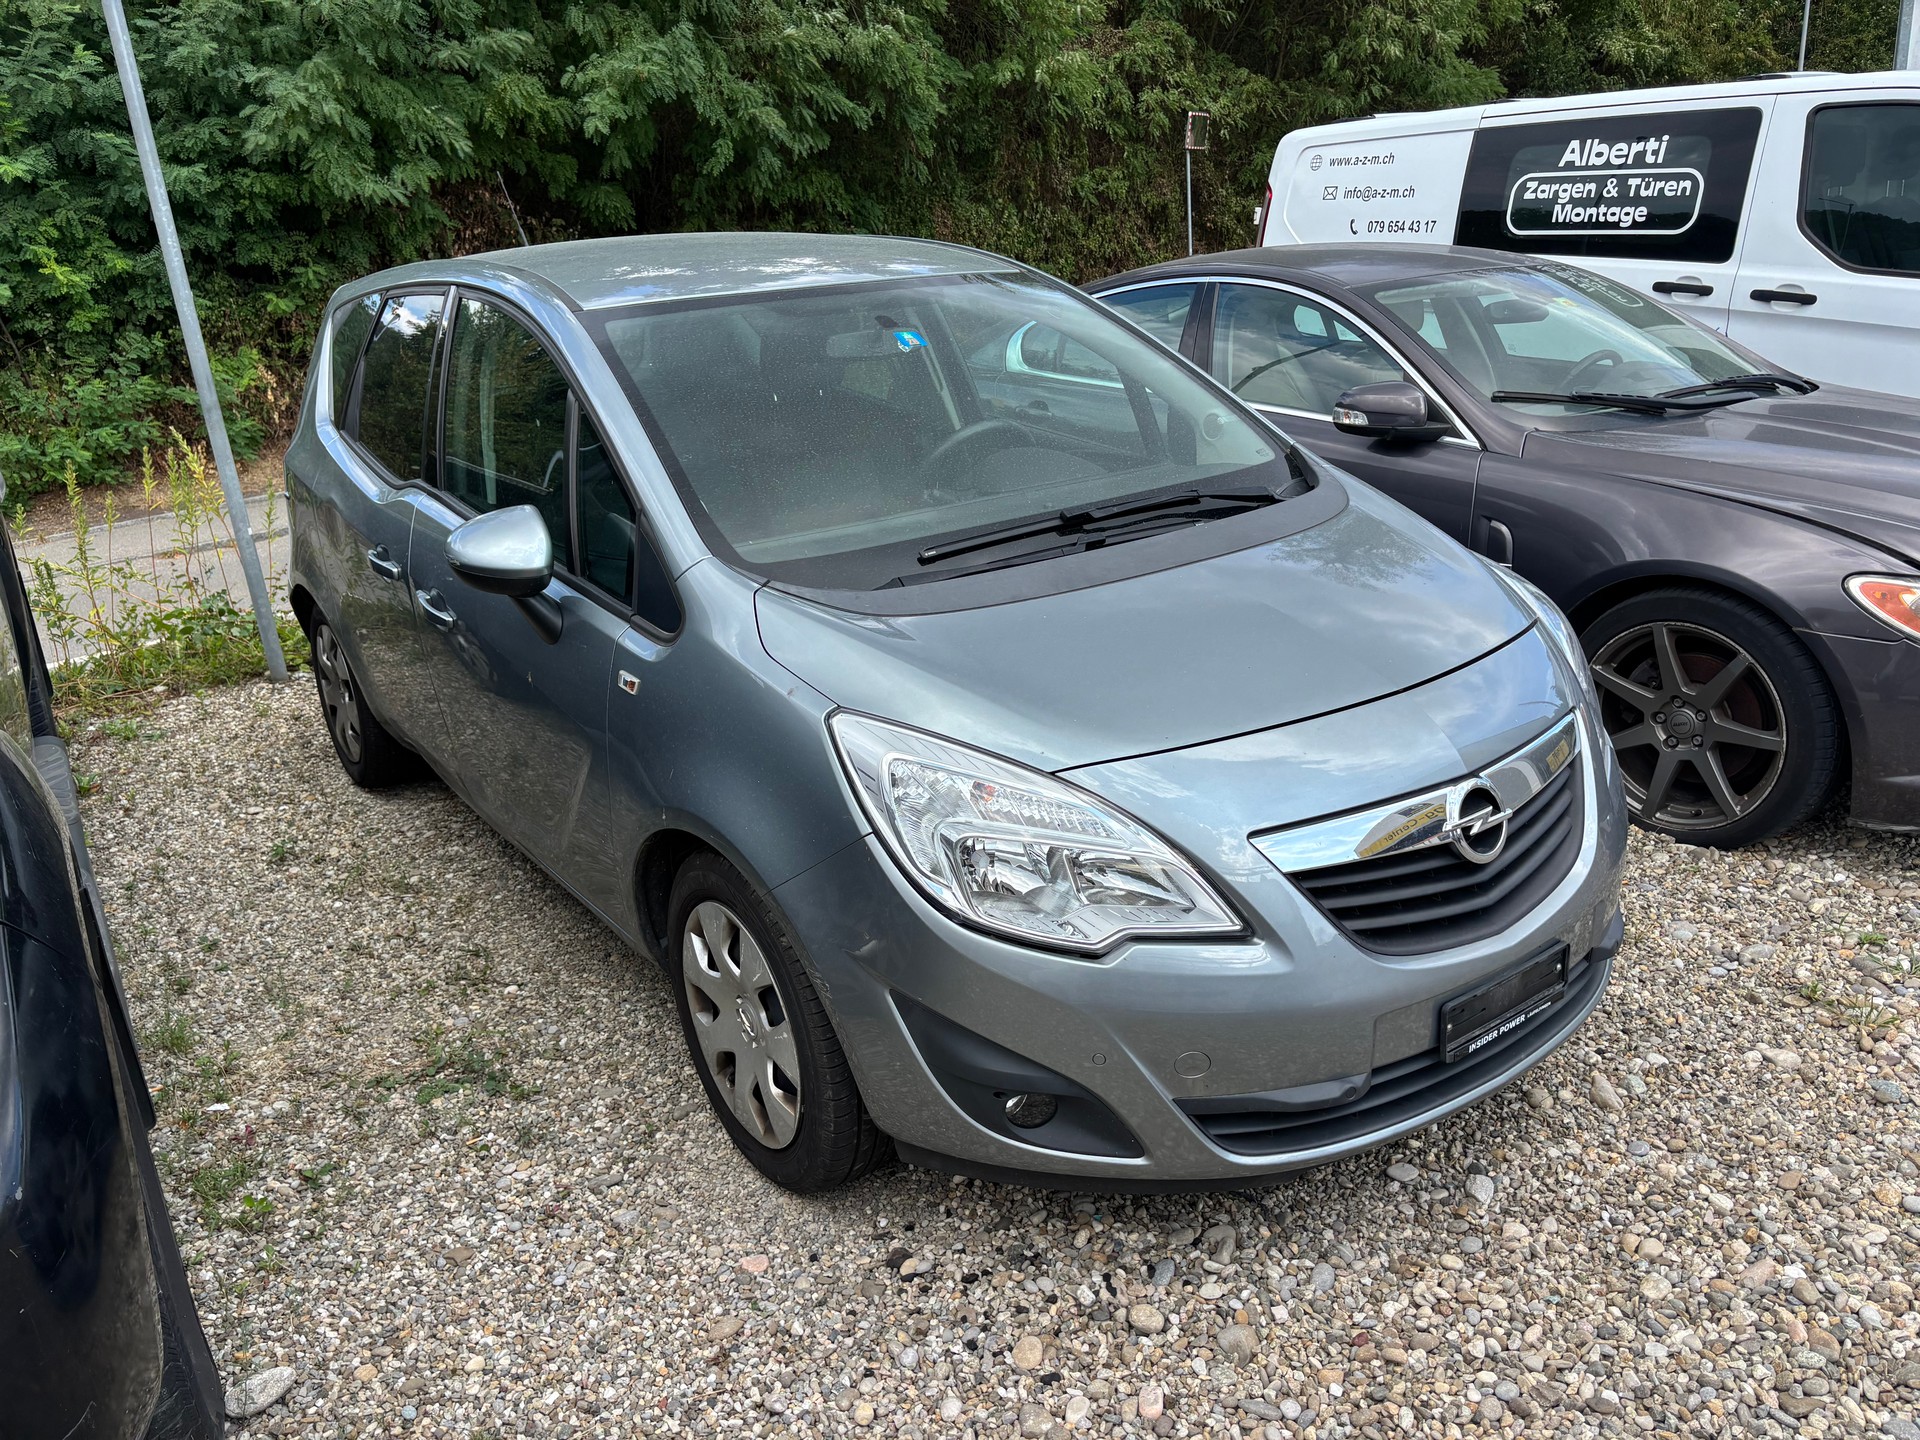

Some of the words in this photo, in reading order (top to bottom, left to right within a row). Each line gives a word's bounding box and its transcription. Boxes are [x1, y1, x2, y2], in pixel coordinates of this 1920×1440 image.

[1329, 152, 1395, 167] www.a-z-m.ch
[1558, 134, 1670, 168] Alberti
[1343, 185, 1415, 202] info@a-z-m.ch
[1523, 180, 1597, 204] Zargen
[1602, 177, 1619, 198] &
[1627, 177, 1692, 197] Türen
[1367, 220, 1385, 233] 079
[1387, 220, 1406, 233] 654
[1408, 220, 1421, 233] 43
[1424, 220, 1437, 233] 17
[1552, 203, 1648, 228] Montage
[1468, 1030, 1498, 1053] INSIDER
[1499, 1014, 1526, 1035] POWER
